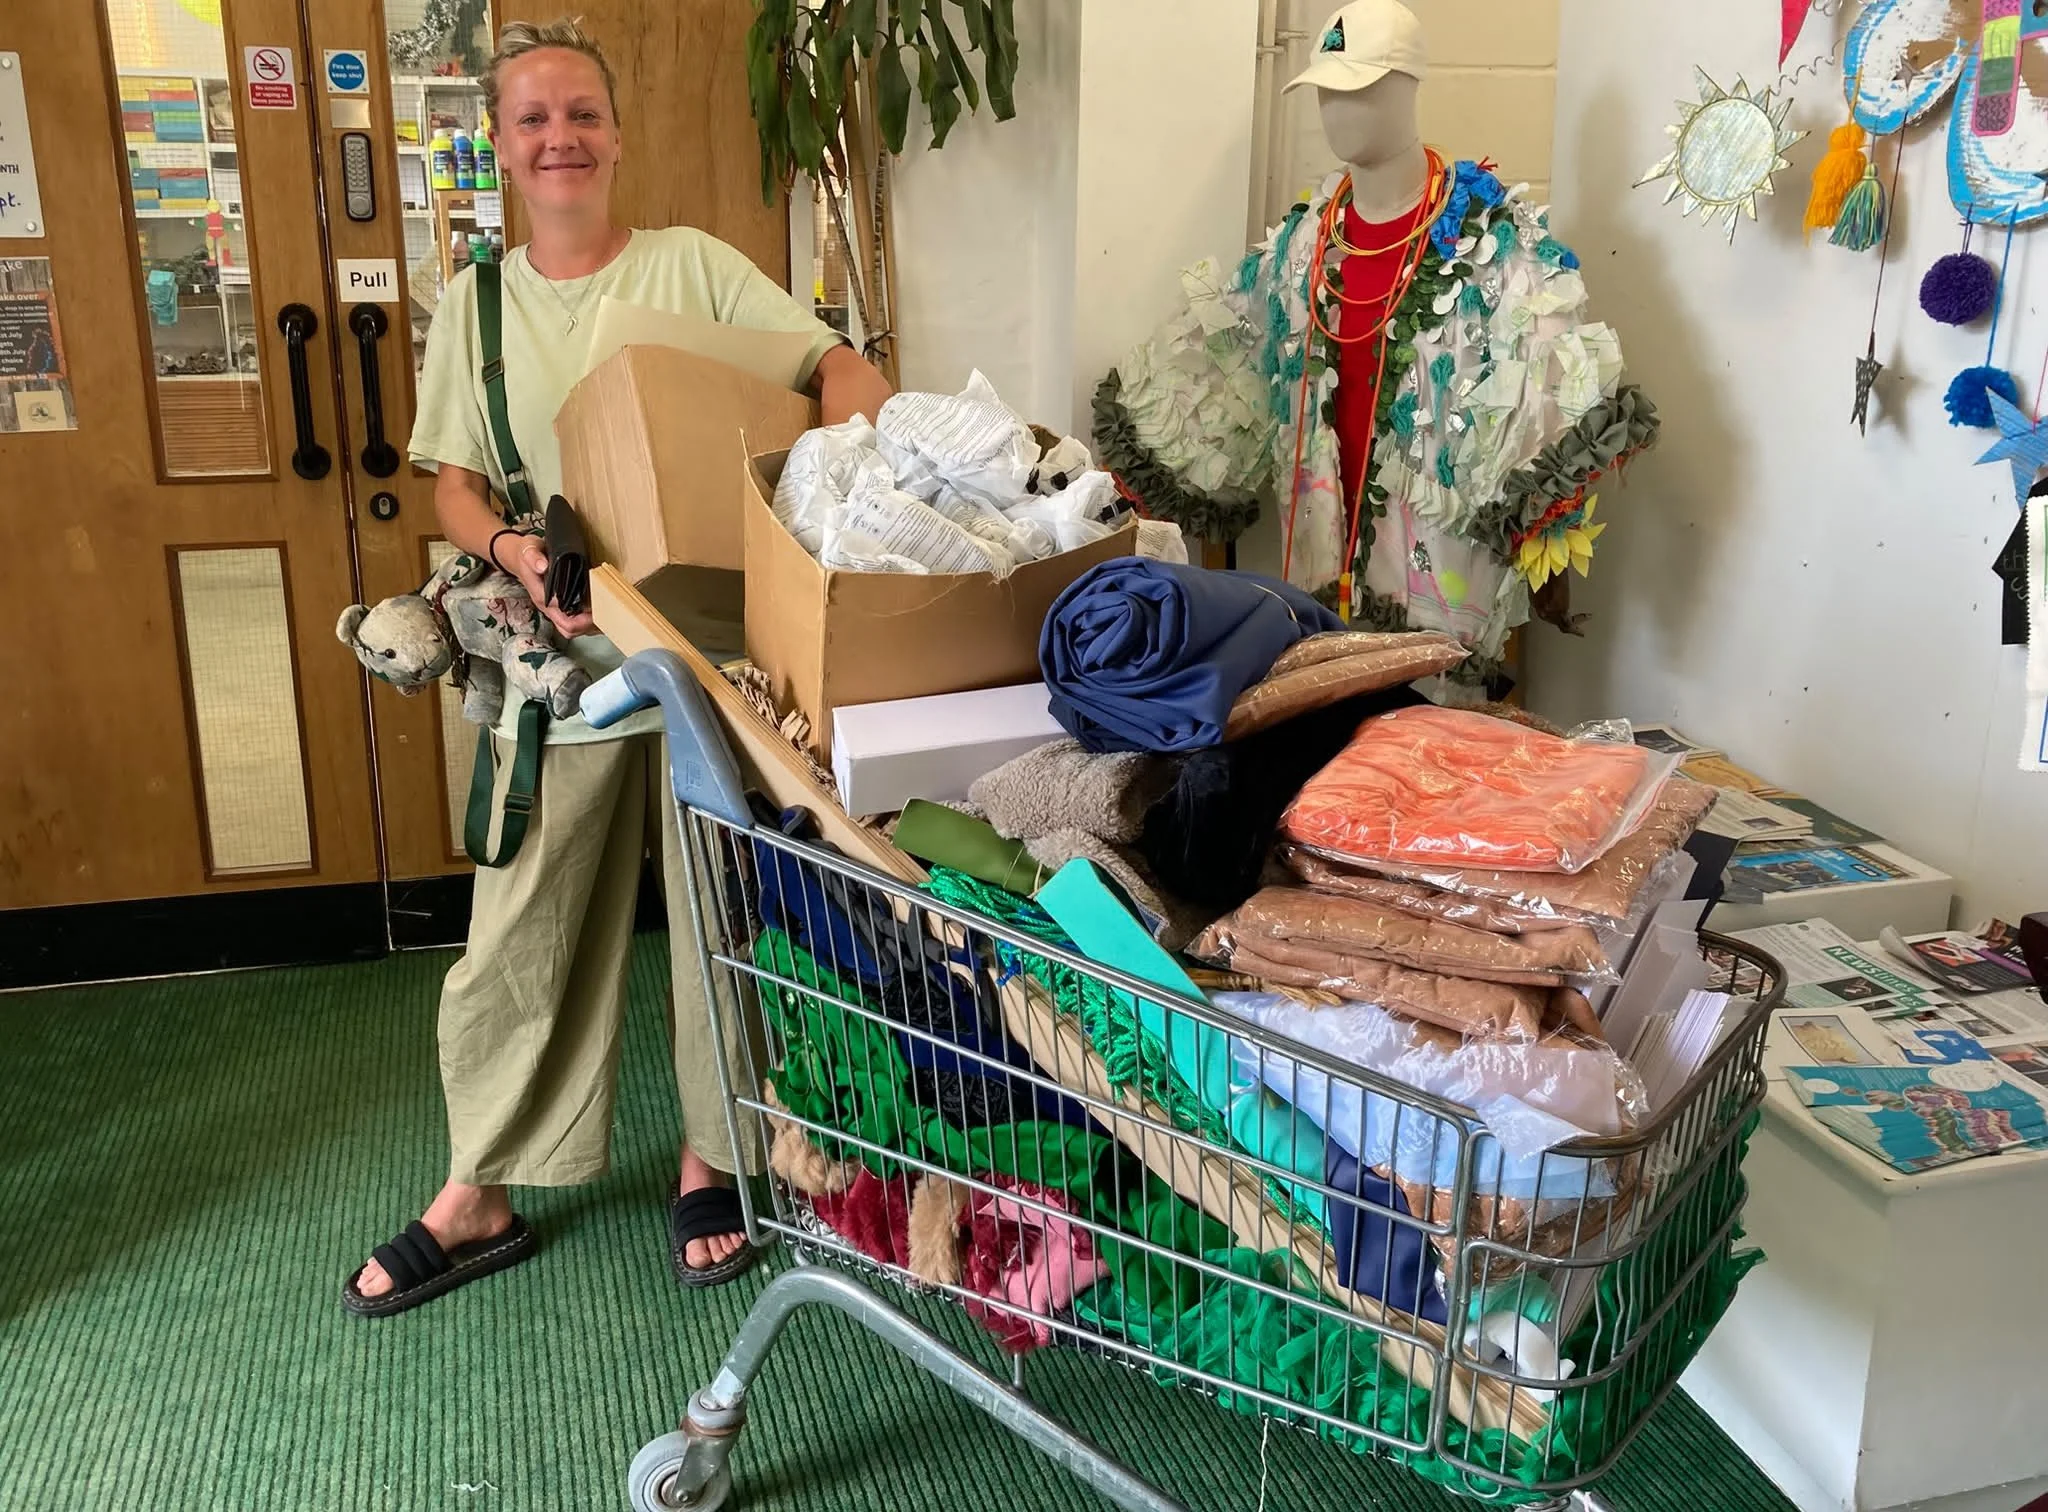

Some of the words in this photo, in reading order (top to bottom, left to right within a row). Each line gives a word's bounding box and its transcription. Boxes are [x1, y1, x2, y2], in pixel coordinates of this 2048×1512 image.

[264, 85, 288, 93] smoking
[350, 271, 387, 288] Pull
[8, 331, 23, 340] July
[12, 349, 26, 357] July
